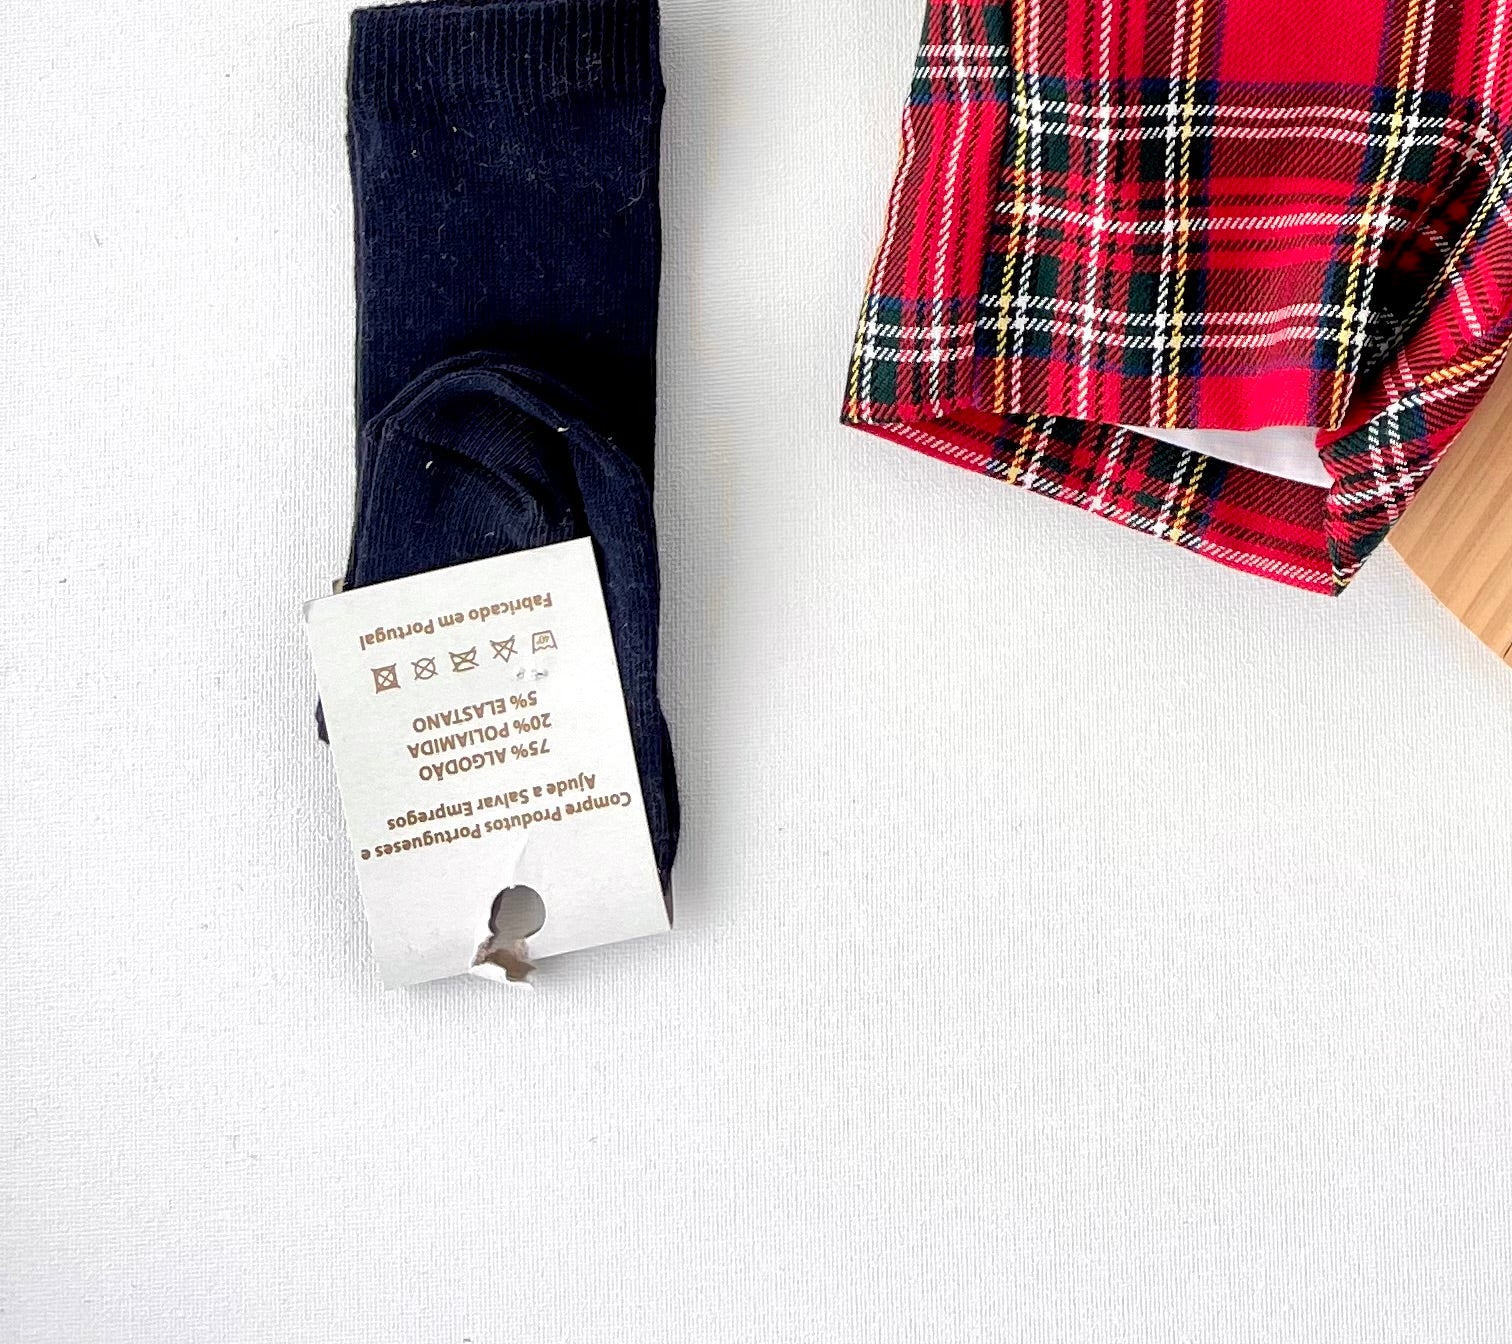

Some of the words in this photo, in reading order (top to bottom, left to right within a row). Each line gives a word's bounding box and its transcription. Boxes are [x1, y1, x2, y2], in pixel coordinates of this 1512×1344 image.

[468, 592, 553, 622] Fabricado
[438, 613, 465, 629] em
[359, 619, 435, 651] Portugal
[509, 690, 538, 710] 5%
[412, 698, 506, 733] ELASTANO
[514, 712, 552, 733] 20%
[407, 721, 509, 759] POLIAMIDA
[511, 738, 550, 761] 75%
[418, 747, 506, 781] ALGODÃO
[476, 787, 529, 812] Salvar
[532, 785, 543, 797] a
[546, 773, 596, 801] Ajude
[387, 800, 473, 831] Empregos
[566, 791, 631, 818] Compre
[485, 807, 561, 834] Produtos
[361, 847, 371, 860] e
[374, 823, 481, 860] Portugueses
